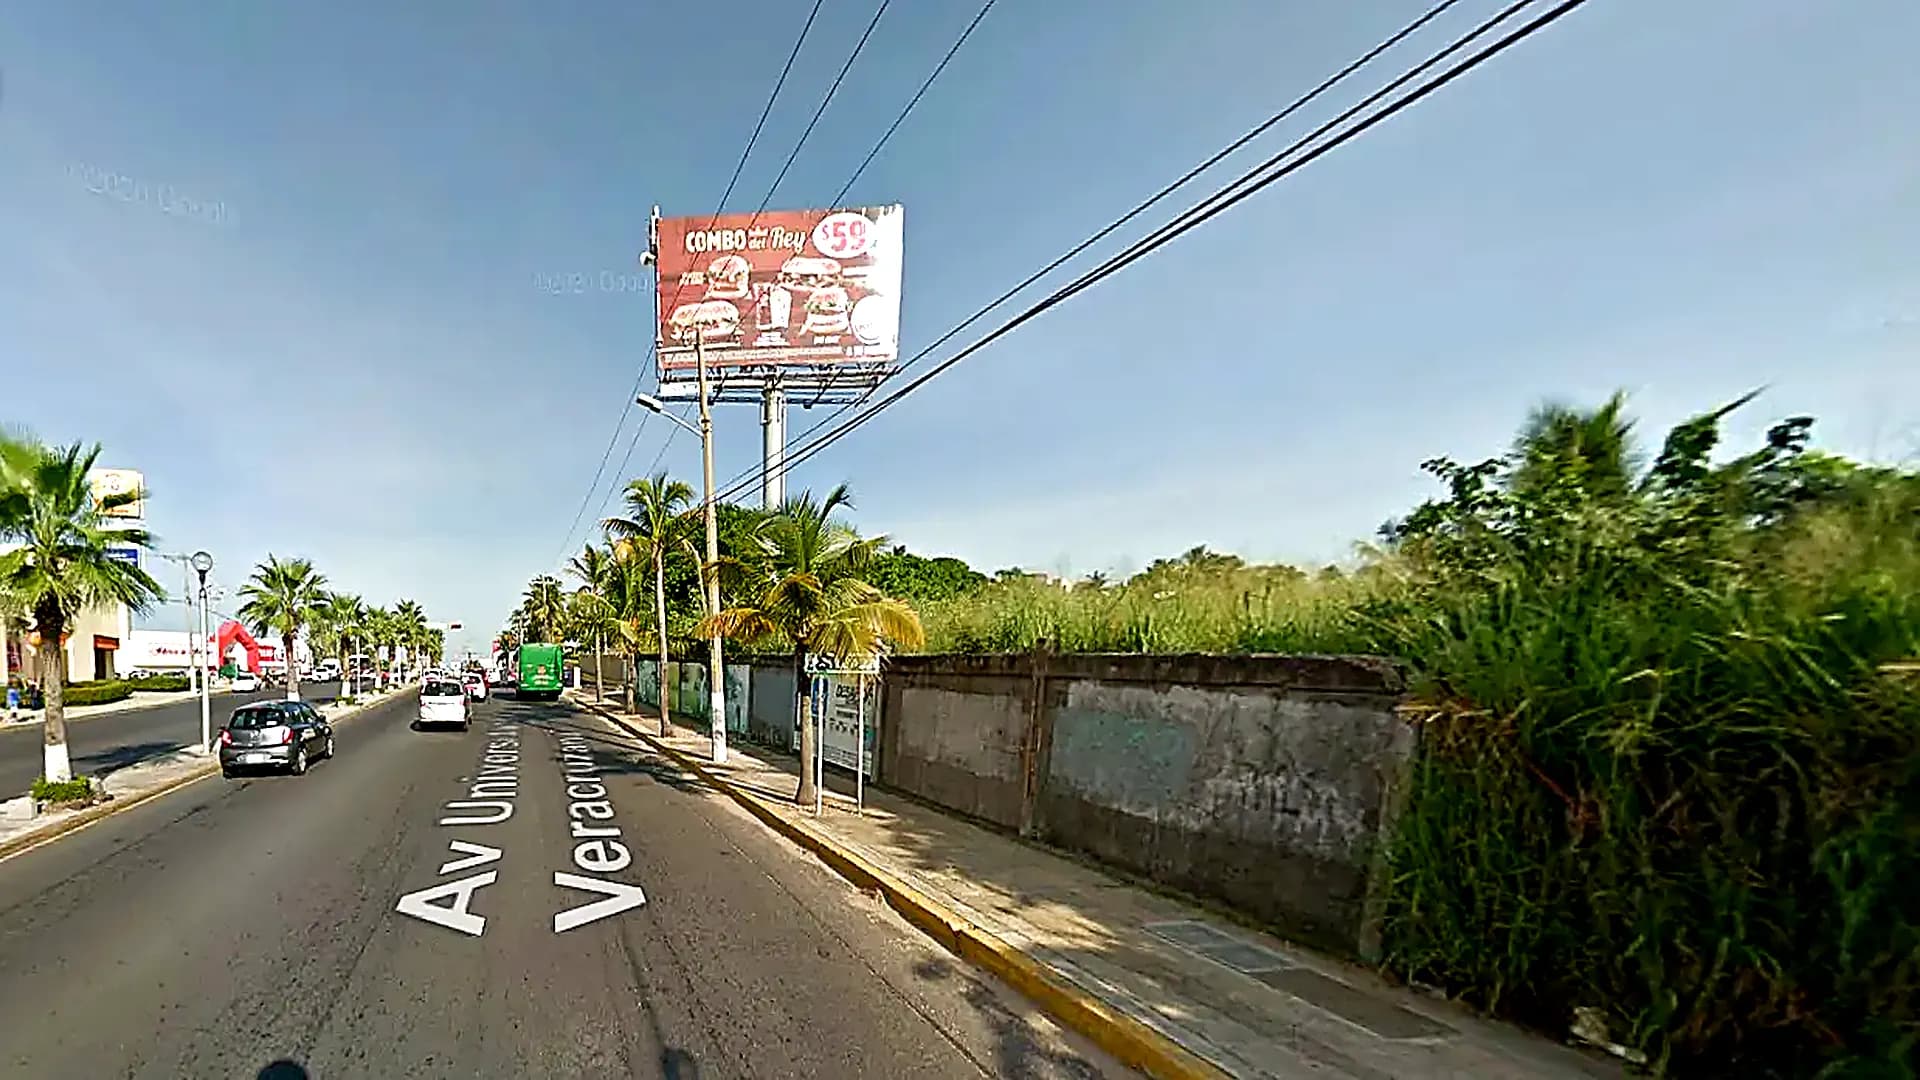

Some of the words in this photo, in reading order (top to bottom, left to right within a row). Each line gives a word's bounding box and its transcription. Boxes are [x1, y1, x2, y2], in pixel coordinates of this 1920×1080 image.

[685, 228, 747, 253] COMBO
[769, 226, 807, 252] Rey
[821, 219, 867, 252] $59
